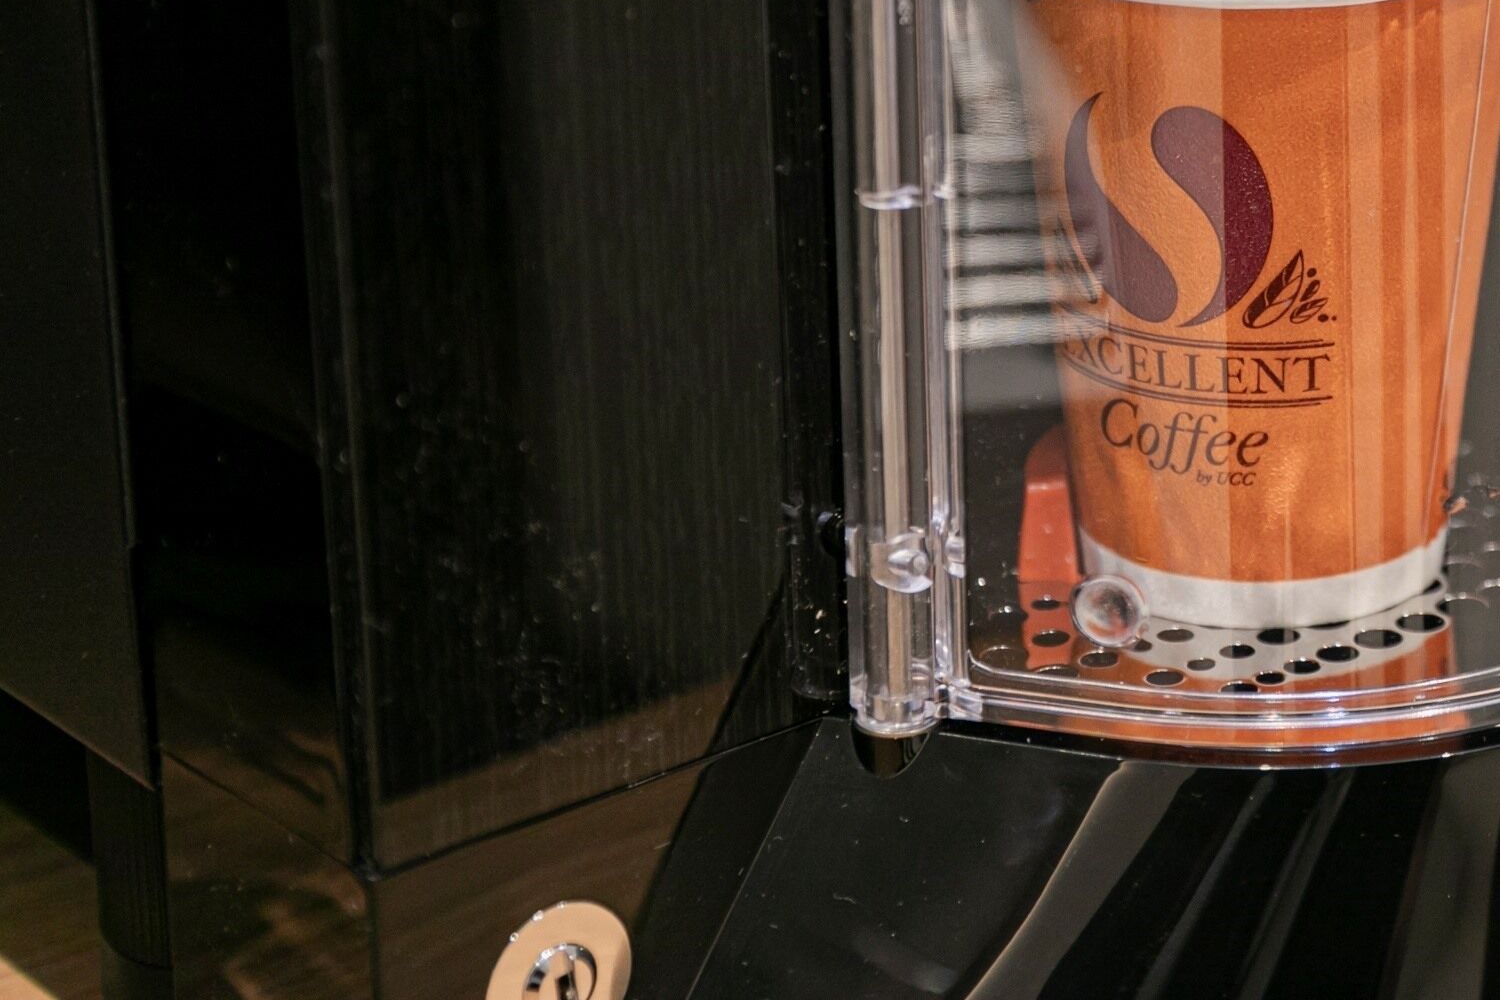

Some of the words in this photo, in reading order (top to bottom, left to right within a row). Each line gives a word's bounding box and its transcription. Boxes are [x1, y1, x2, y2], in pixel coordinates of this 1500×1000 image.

[1101, 399, 1269, 474] Coffee
[1196, 470, 1212, 486] by
[1217, 471, 1256, 486] UCC
